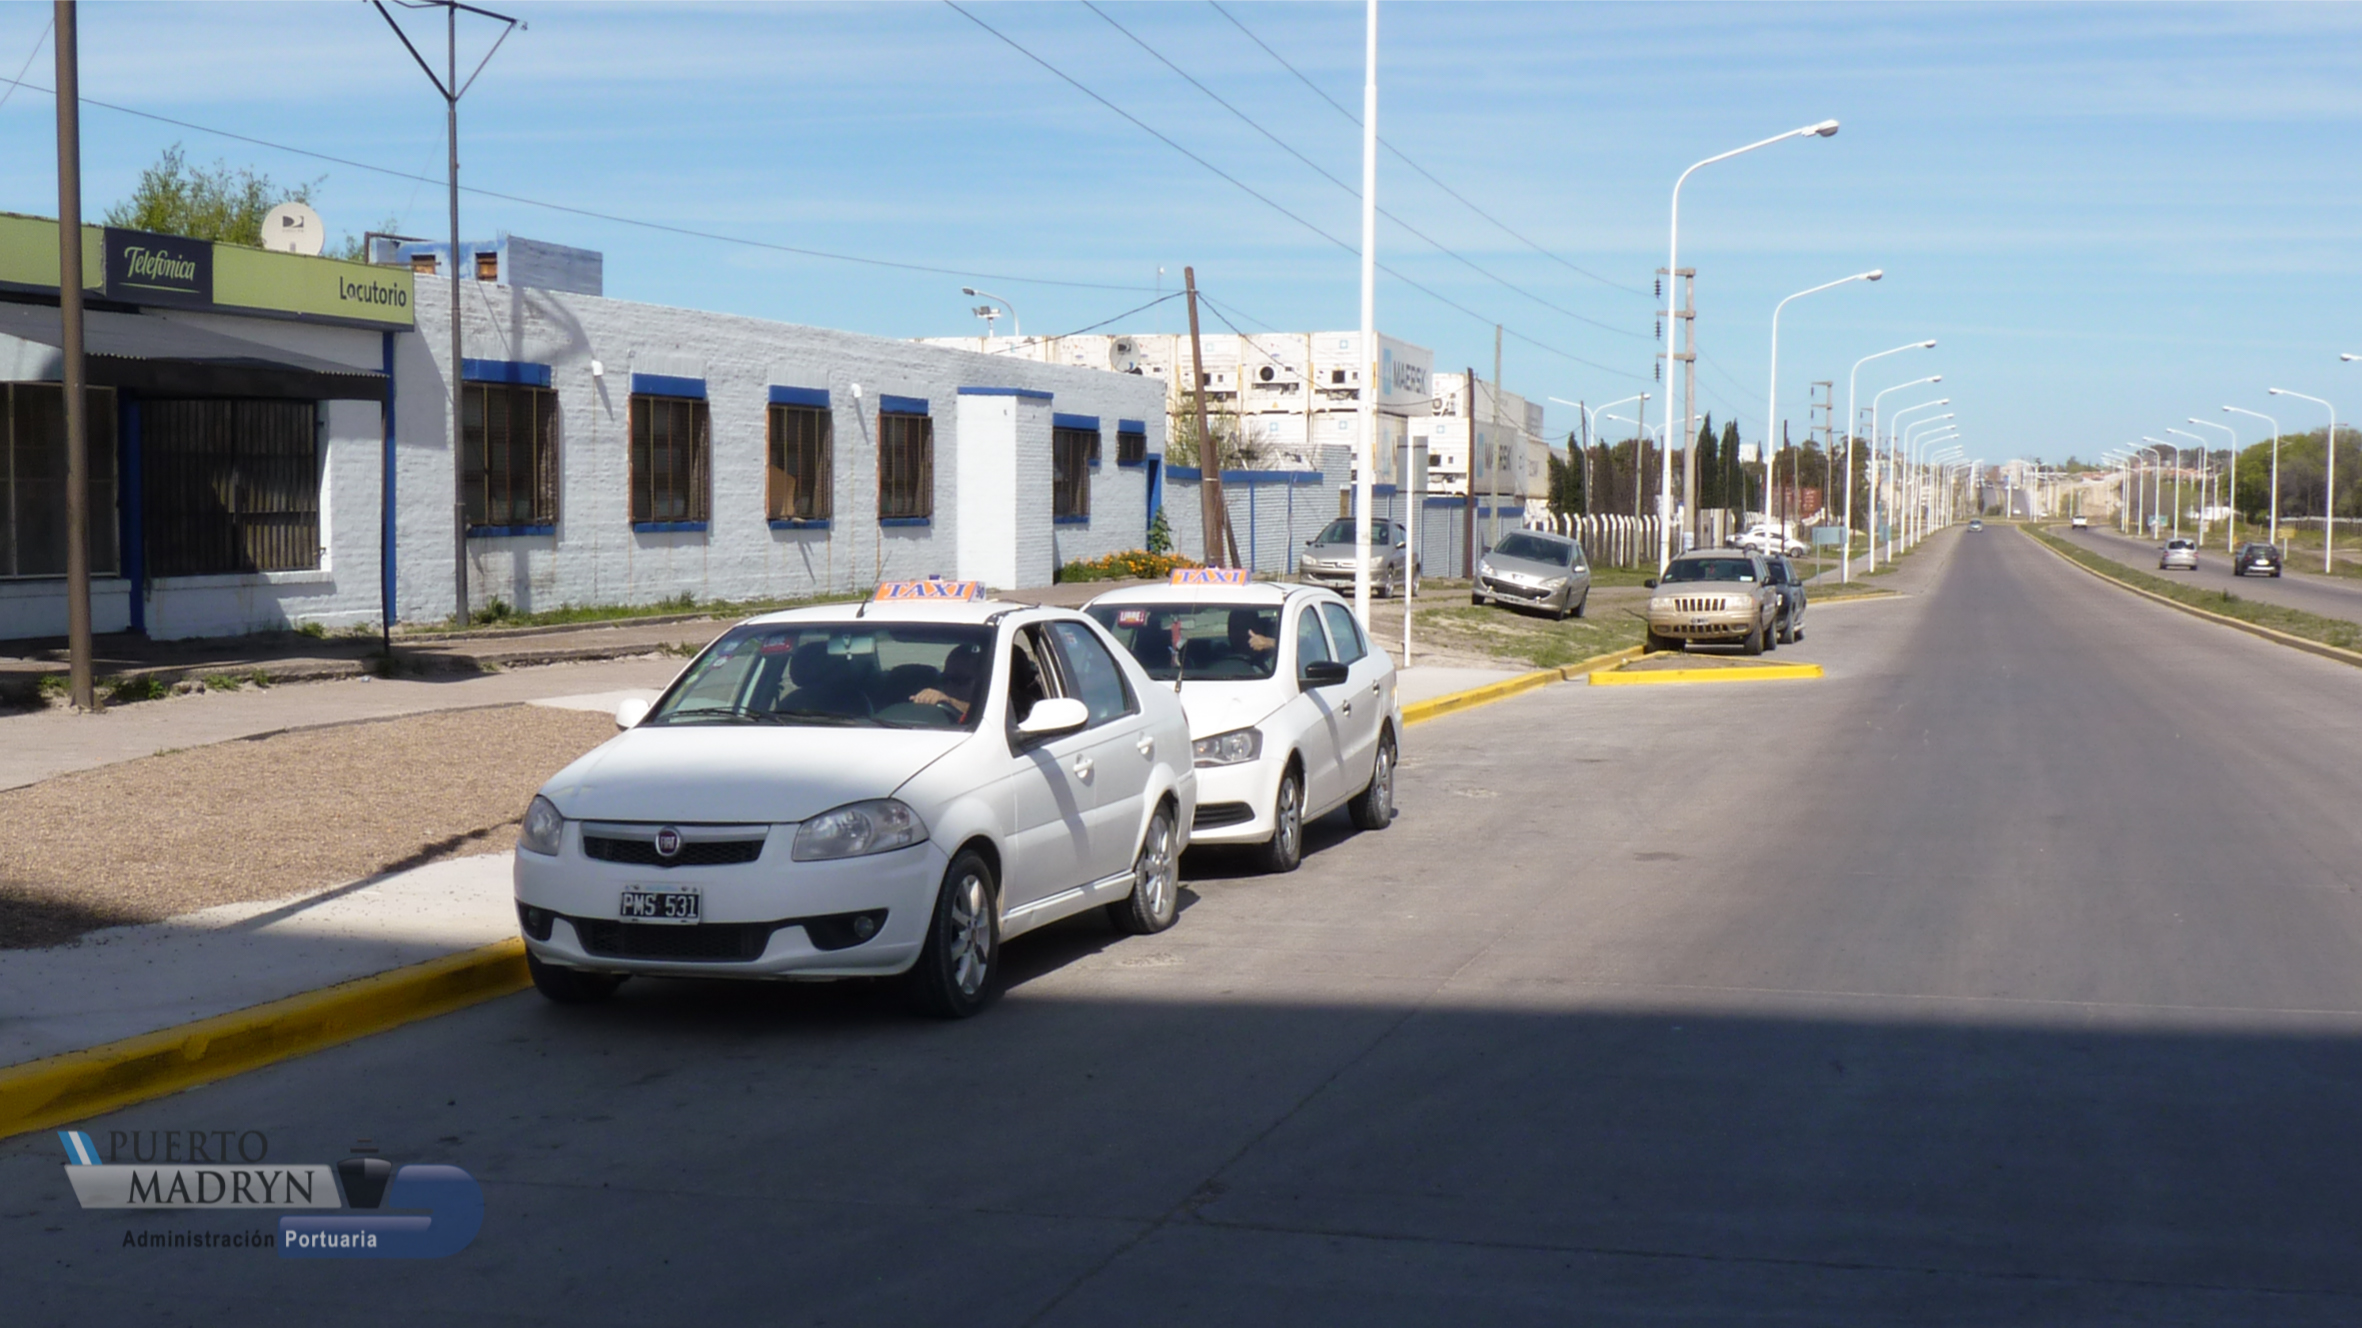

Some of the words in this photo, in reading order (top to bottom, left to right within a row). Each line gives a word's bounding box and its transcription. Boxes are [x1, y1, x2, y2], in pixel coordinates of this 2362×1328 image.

[340, 276, 407, 307] Locutorio
[1393, 360, 1427, 395] MAERSK
[1179, 570, 1242, 583] TAXI
[885, 583, 970, 598] TAXI
[622, 894, 656, 916] PMS
[665, 895, 697, 917] 531
